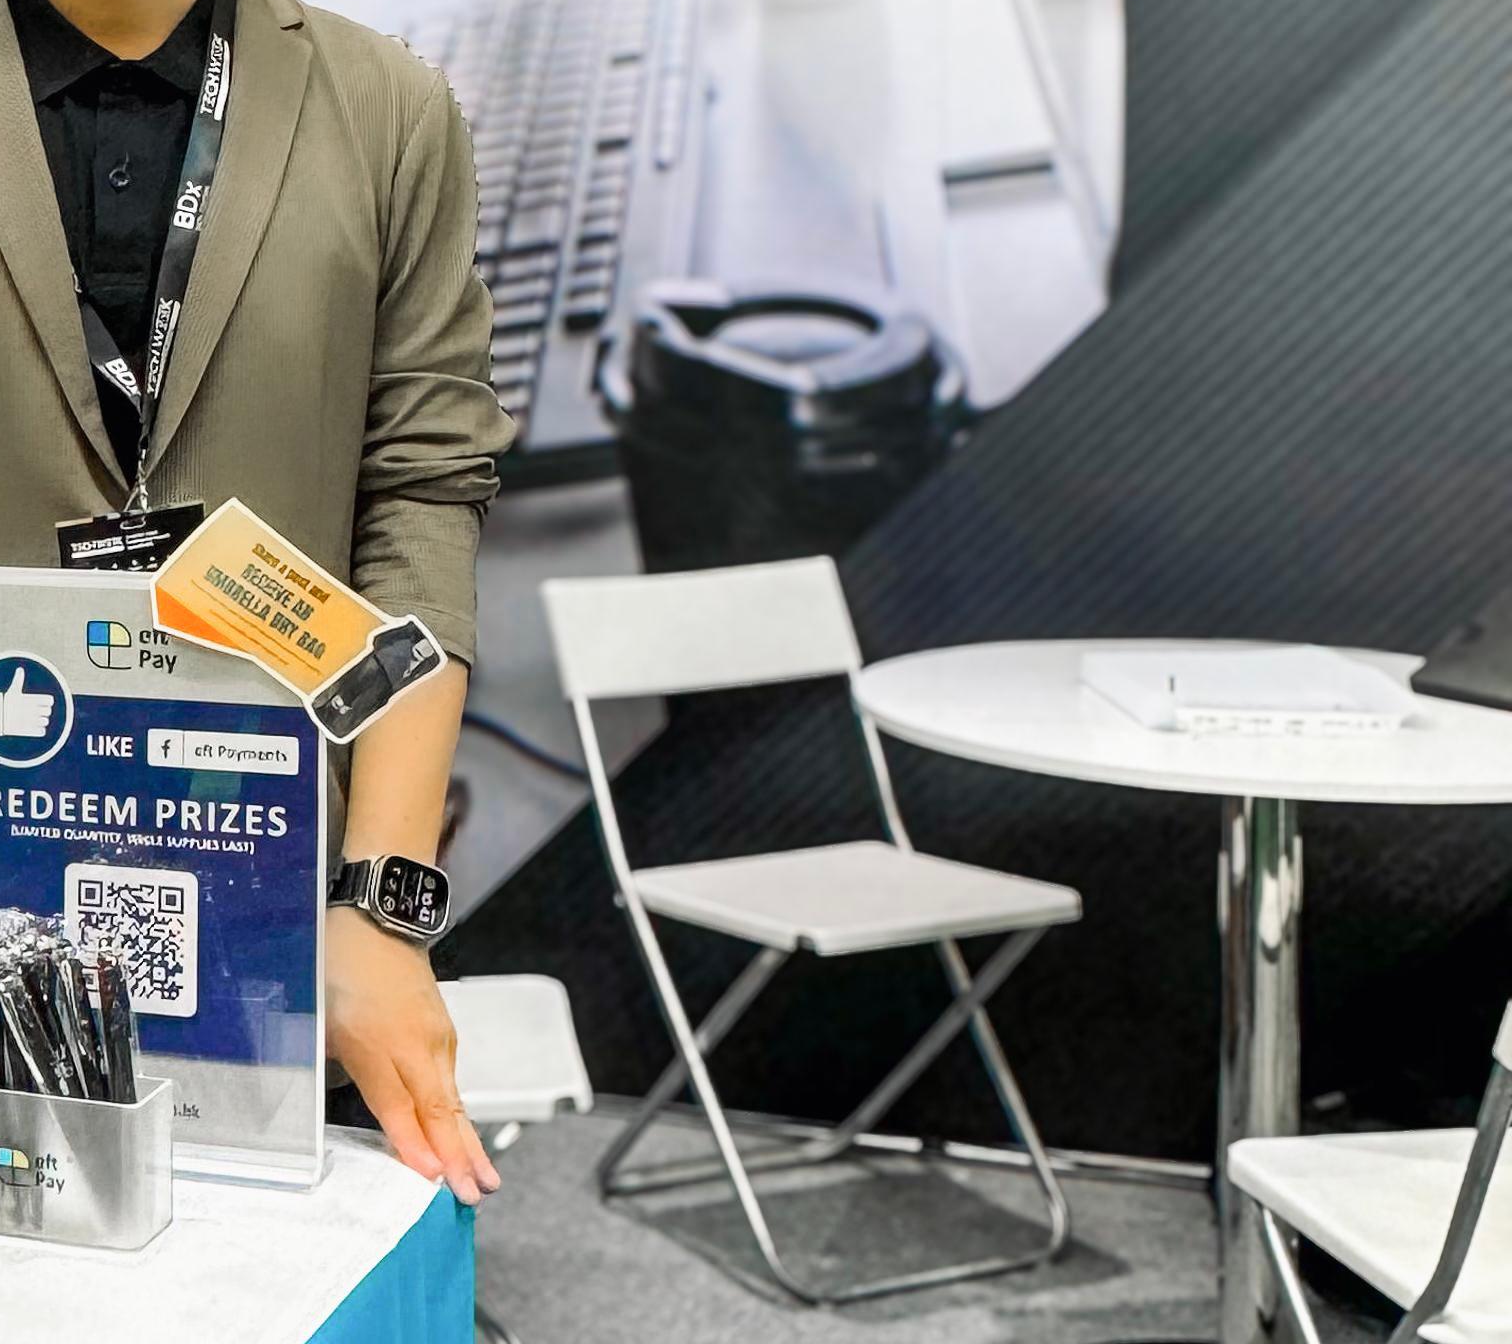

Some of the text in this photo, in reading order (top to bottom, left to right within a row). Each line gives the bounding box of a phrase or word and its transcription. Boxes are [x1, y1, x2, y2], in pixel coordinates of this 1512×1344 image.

[173, 180, 202, 230] BDX
[139, 649, 177, 674] Pay
[87, 734, 134, 757] LIKE
[155, 798, 288, 838] PRIZES
[36, 1171, 65, 1194] Pay
